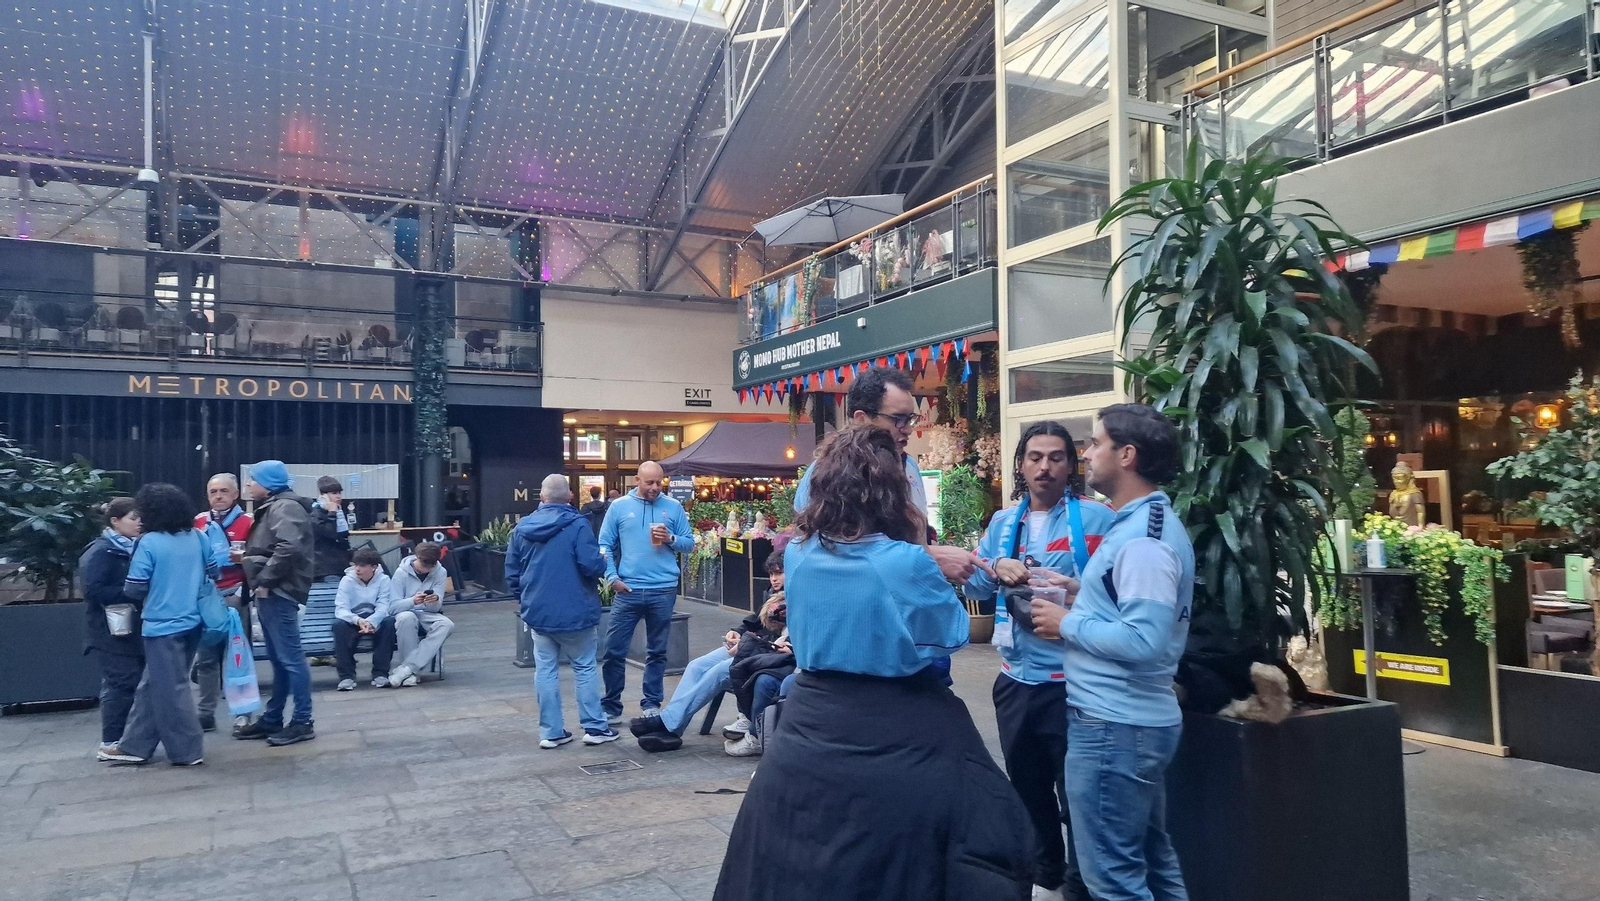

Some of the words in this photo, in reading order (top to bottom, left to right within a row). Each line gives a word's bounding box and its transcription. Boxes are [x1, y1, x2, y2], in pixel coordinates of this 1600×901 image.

[753, 352, 772, 368] MOMO
[772, 347, 787, 363] HUB
[787, 338, 815, 359] MOTHER
[816, 332, 841, 351] NEPAL
[128, 374, 410, 401] METROPOLITAN
[684, 388, 711, 398] EXIT
[1387, 661, 1399, 669] WE
[1400, 662, 1415, 671] ARE
[1415, 665, 1440, 674] INSIDE
